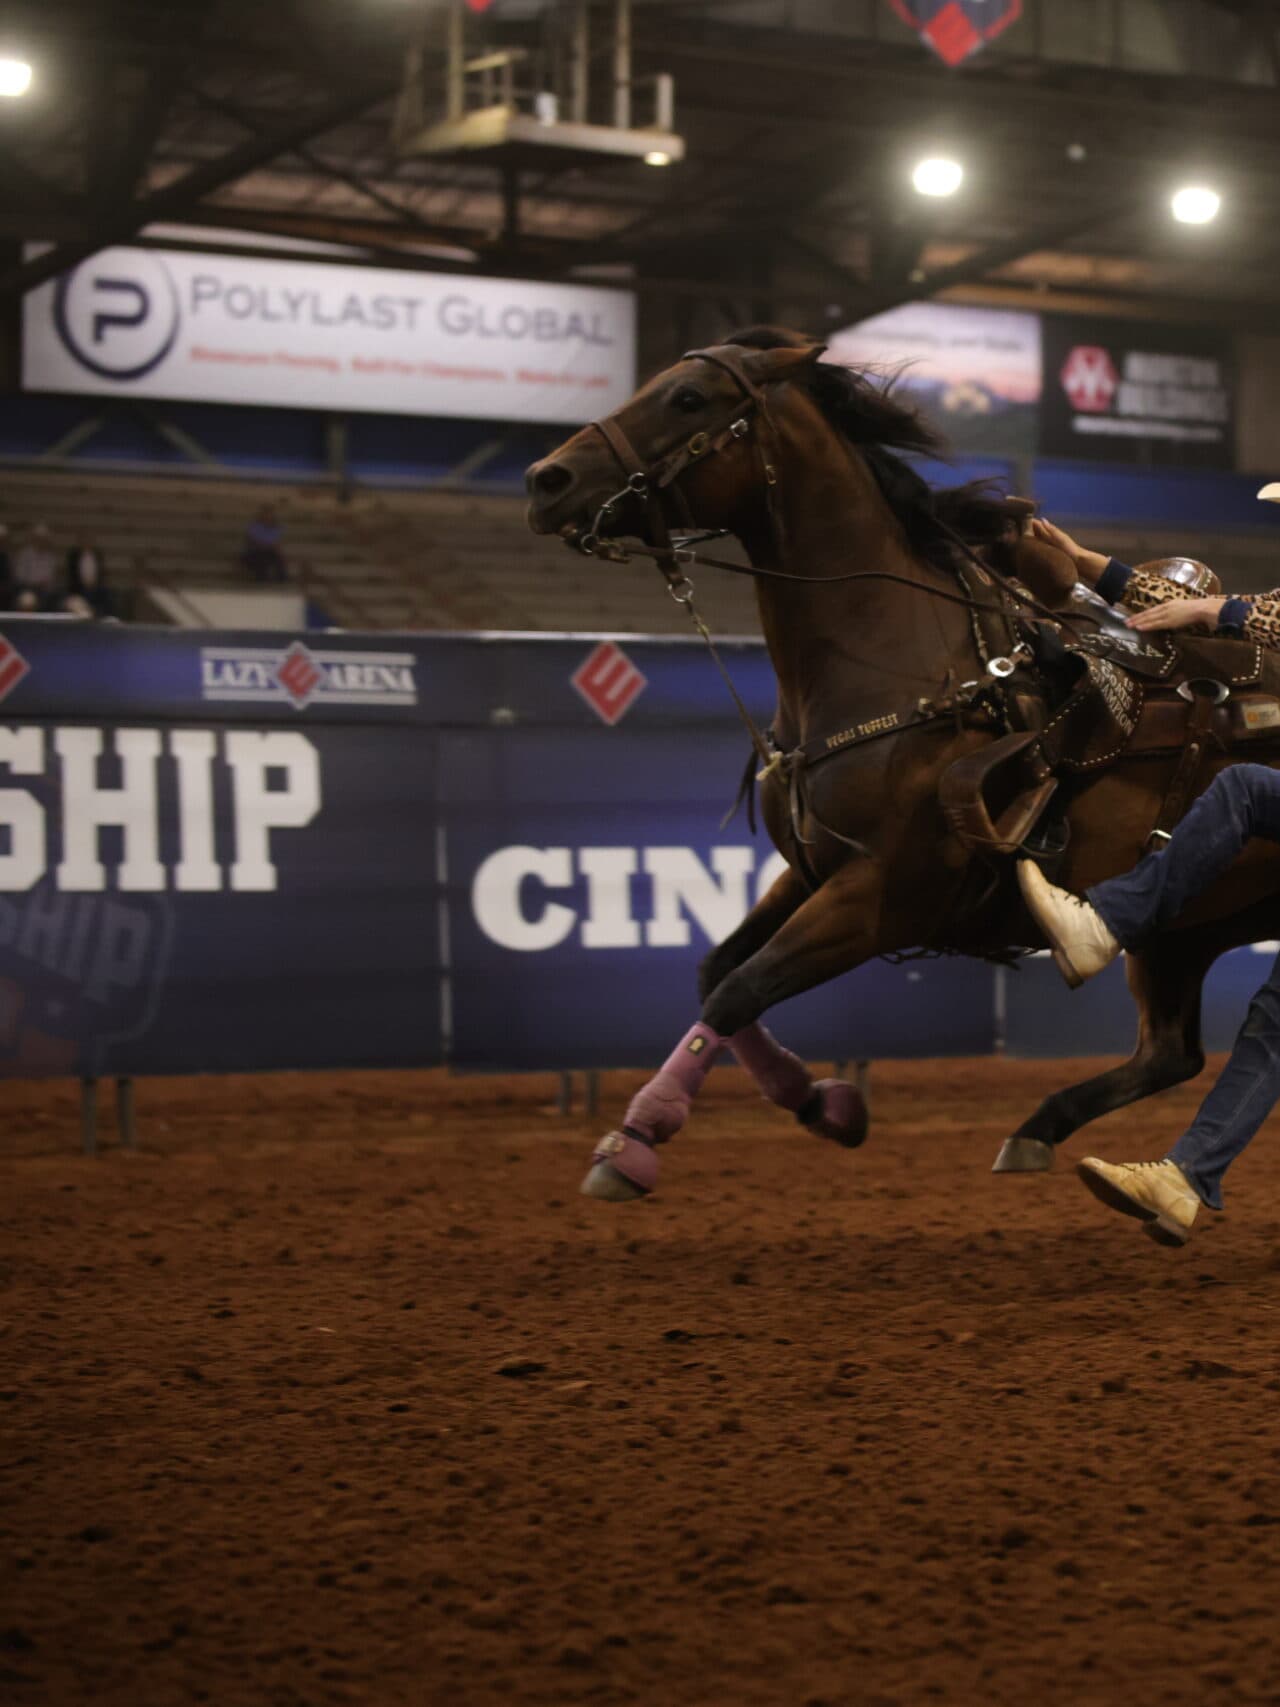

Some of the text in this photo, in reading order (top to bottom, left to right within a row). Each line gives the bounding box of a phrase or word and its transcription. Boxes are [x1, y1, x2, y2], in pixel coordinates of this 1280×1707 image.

[191, 275, 614, 347] POLYLAST GLOBAL
[203, 660, 274, 689] LAZY
[324, 663, 416, 692] ARENA
[825, 727, 856, 749] VEGAS
[471, 845, 792, 952] CIN
